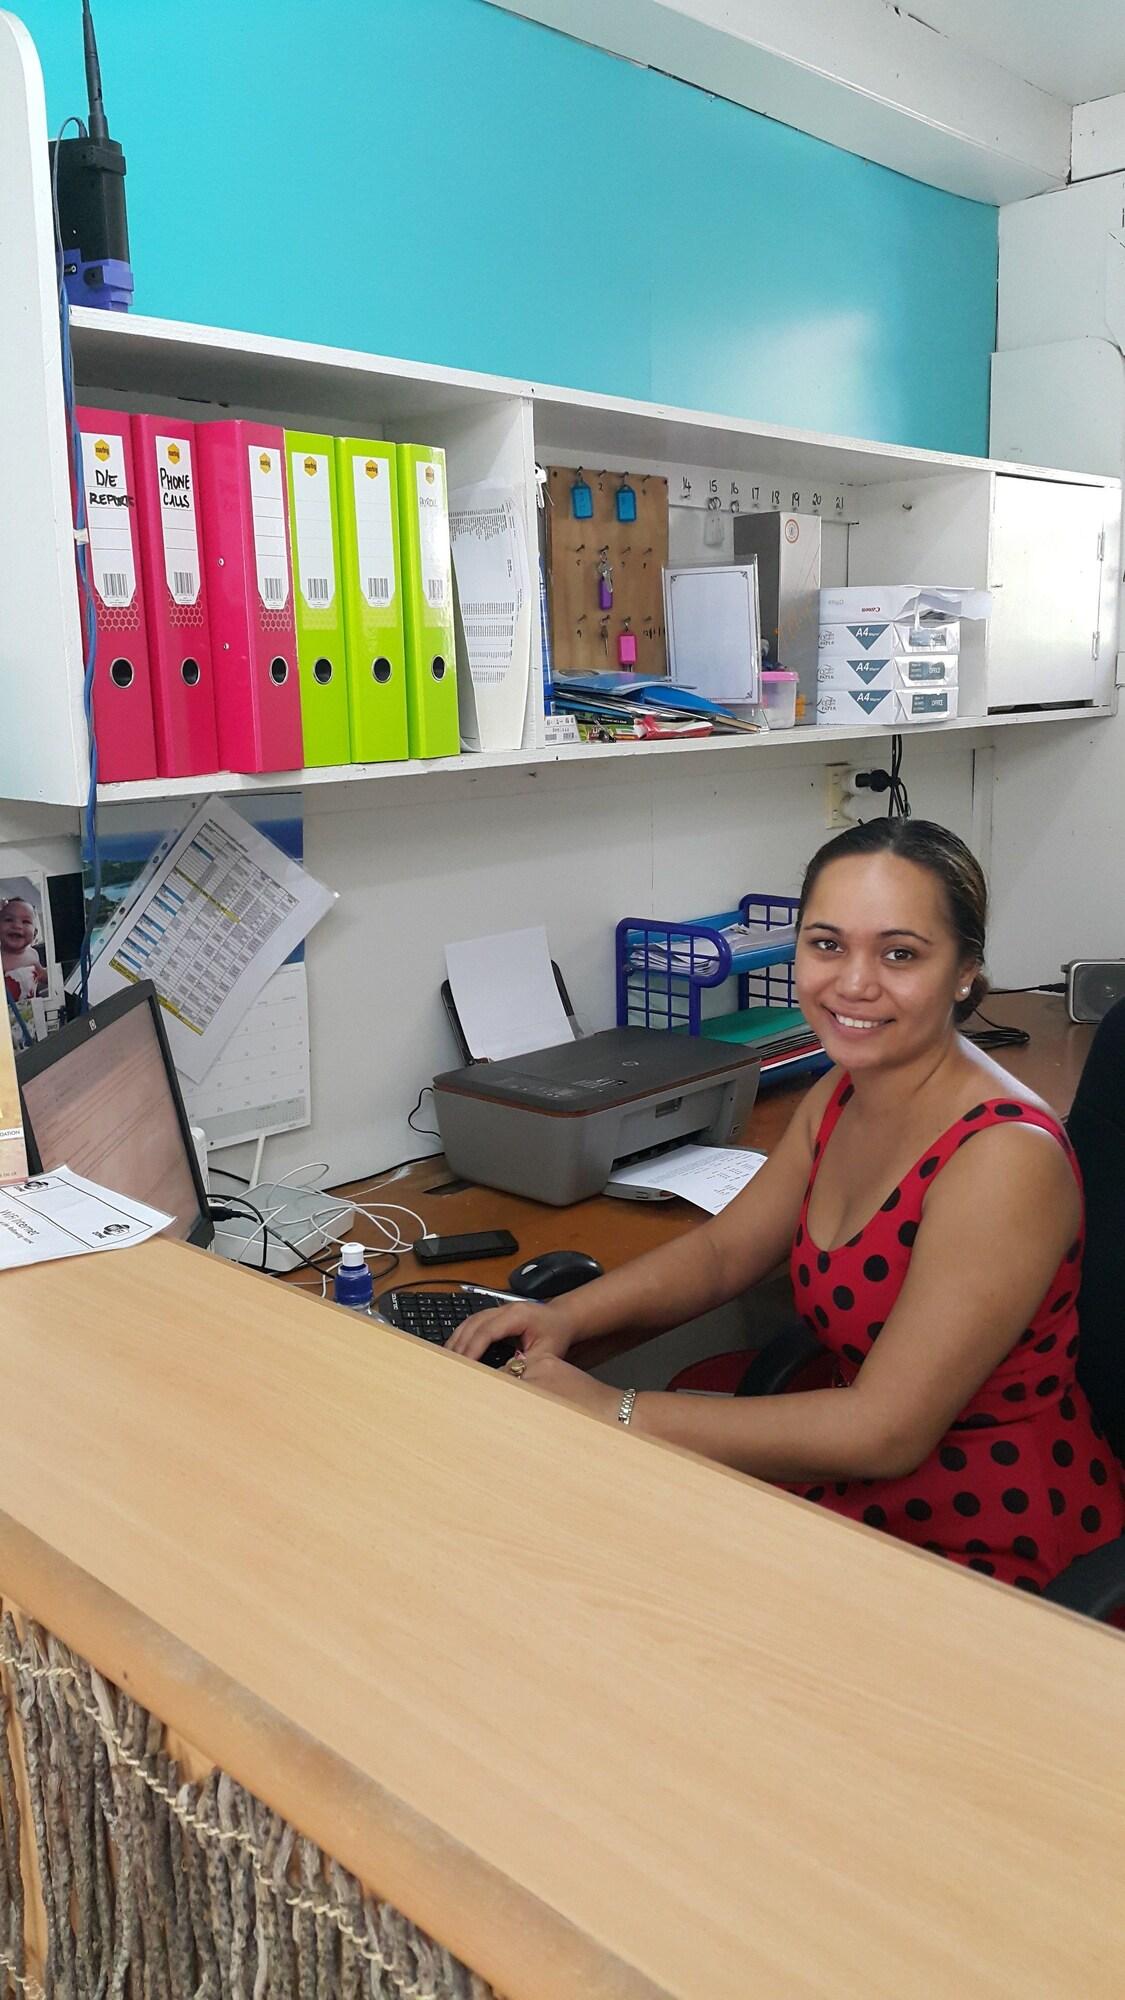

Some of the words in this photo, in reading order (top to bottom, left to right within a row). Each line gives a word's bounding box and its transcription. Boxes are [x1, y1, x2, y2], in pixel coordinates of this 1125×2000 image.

[160, 467, 190, 490] PHONE
[682, 476, 692, 493] 14
[709, 479, 718, 493] 15
[730, 482, 739, 495] 16
[163, 492, 190, 508] CALLS
[751, 487, 760, 500] 17
[771, 490, 780, 504] 18
[791, 492, 800, 507] 19
[812, 493, 822, 506] 20
[835, 496, 844, 510] 21
[855, 627, 869, 637] A4
[855, 662, 870, 672] A4
[856, 692, 871, 702] A4
